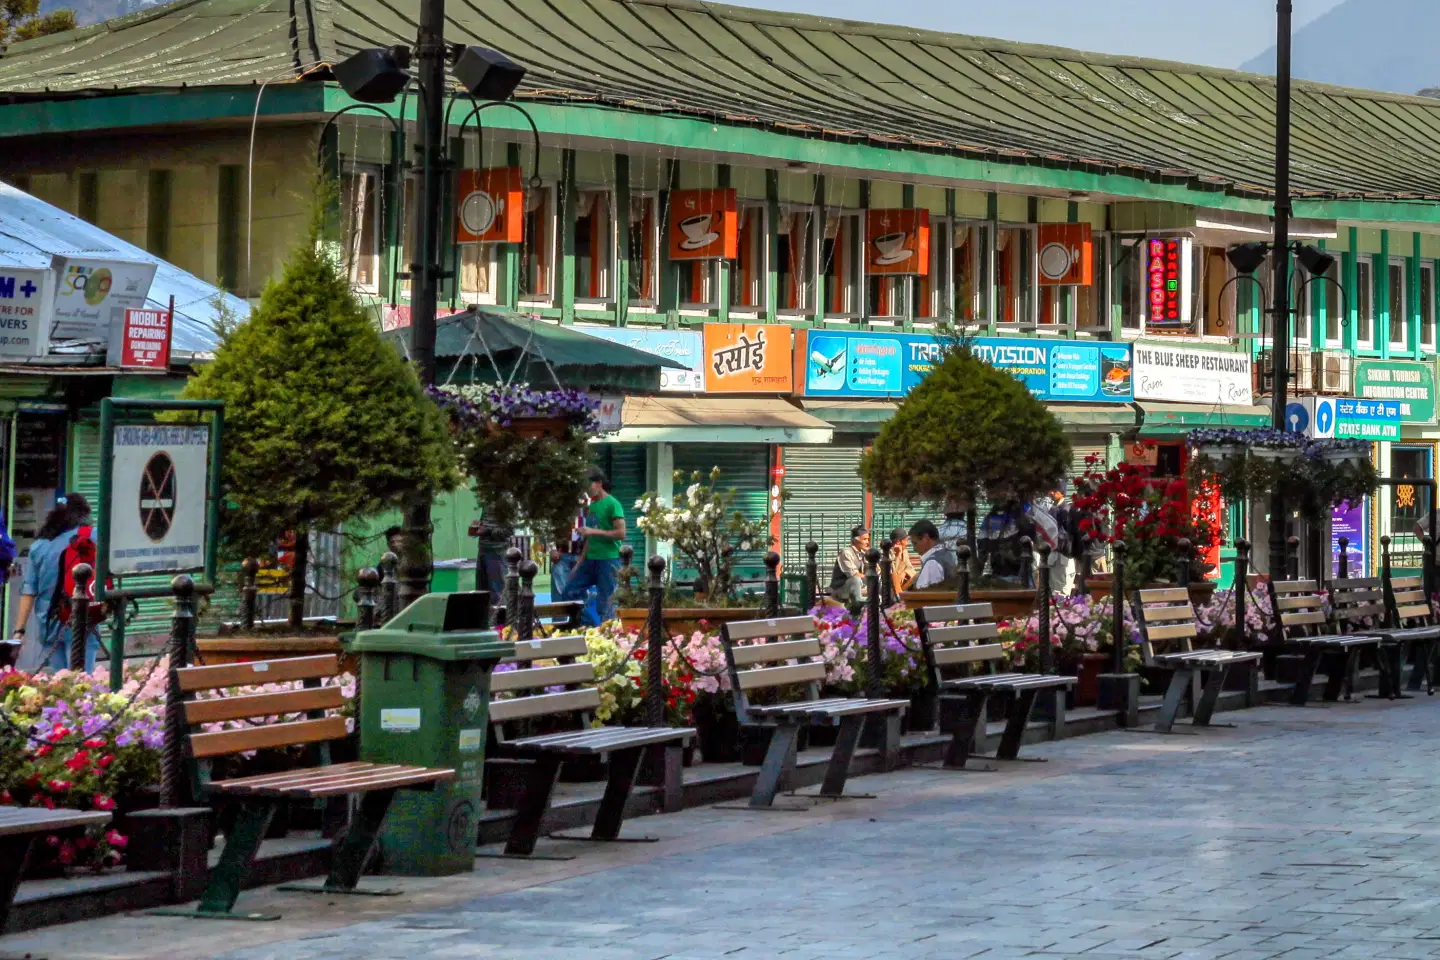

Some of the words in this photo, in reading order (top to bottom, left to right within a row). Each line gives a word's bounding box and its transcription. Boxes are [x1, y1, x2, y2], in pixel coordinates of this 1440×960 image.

[1149, 239, 1165, 322] RASOI
[129, 311, 167, 327] MOBILE
[129, 327, 166, 340] REPAIRING
[713, 331, 765, 377] रसोई
[1137, 350, 1152, 365] THE
[1154, 351, 1174, 367] BLUE
[1176, 353, 1200, 369] SHEEP
[1201, 356, 1249, 373] RESTAURANT
[1367, 368, 1391, 382] SIKKIM
[1392, 369, 1421, 383] TOURISM
[1363, 385, 1405, 398] INFORMATION
[1405, 386, 1428, 400] CENTRE
[1338, 422, 1361, 435] STATE
[1361, 424, 1381, 436] BANK
[1382, 425, 1397, 437] ATM
